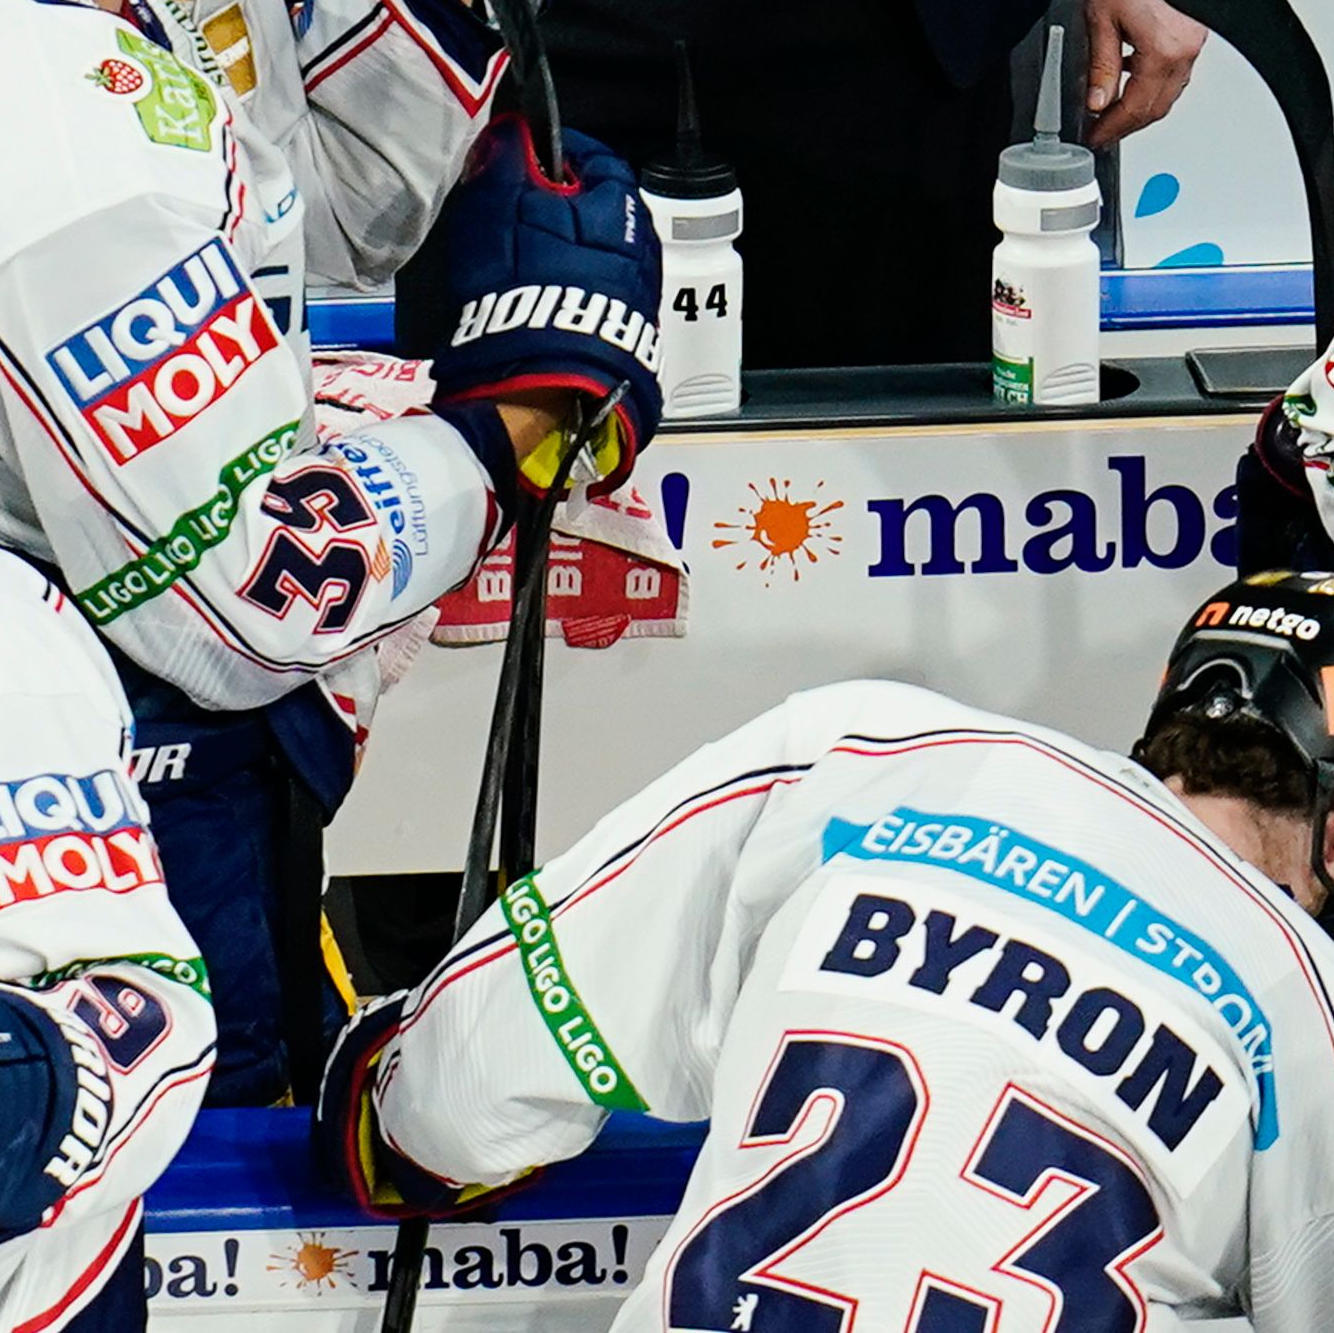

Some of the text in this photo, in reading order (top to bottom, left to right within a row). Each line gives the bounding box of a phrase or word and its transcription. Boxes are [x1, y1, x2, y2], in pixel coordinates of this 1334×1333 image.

[51, 248, 245, 406] LIQUI
[672, 283, 729, 322] 44
[95, 308, 275, 460] MOLY
[867, 455, 1238, 578] mab
[83, 570, 148, 618] LIGO
[1229, 603, 1321, 640] netgo
[864, 811, 1107, 918] EISBÄREN
[528, 943, 570, 1013] LIGO
[558, 1016, 617, 1094] LIGO
[821, 892, 1225, 1153] BYRON
[664, 1031, 1167, 1333] 23
